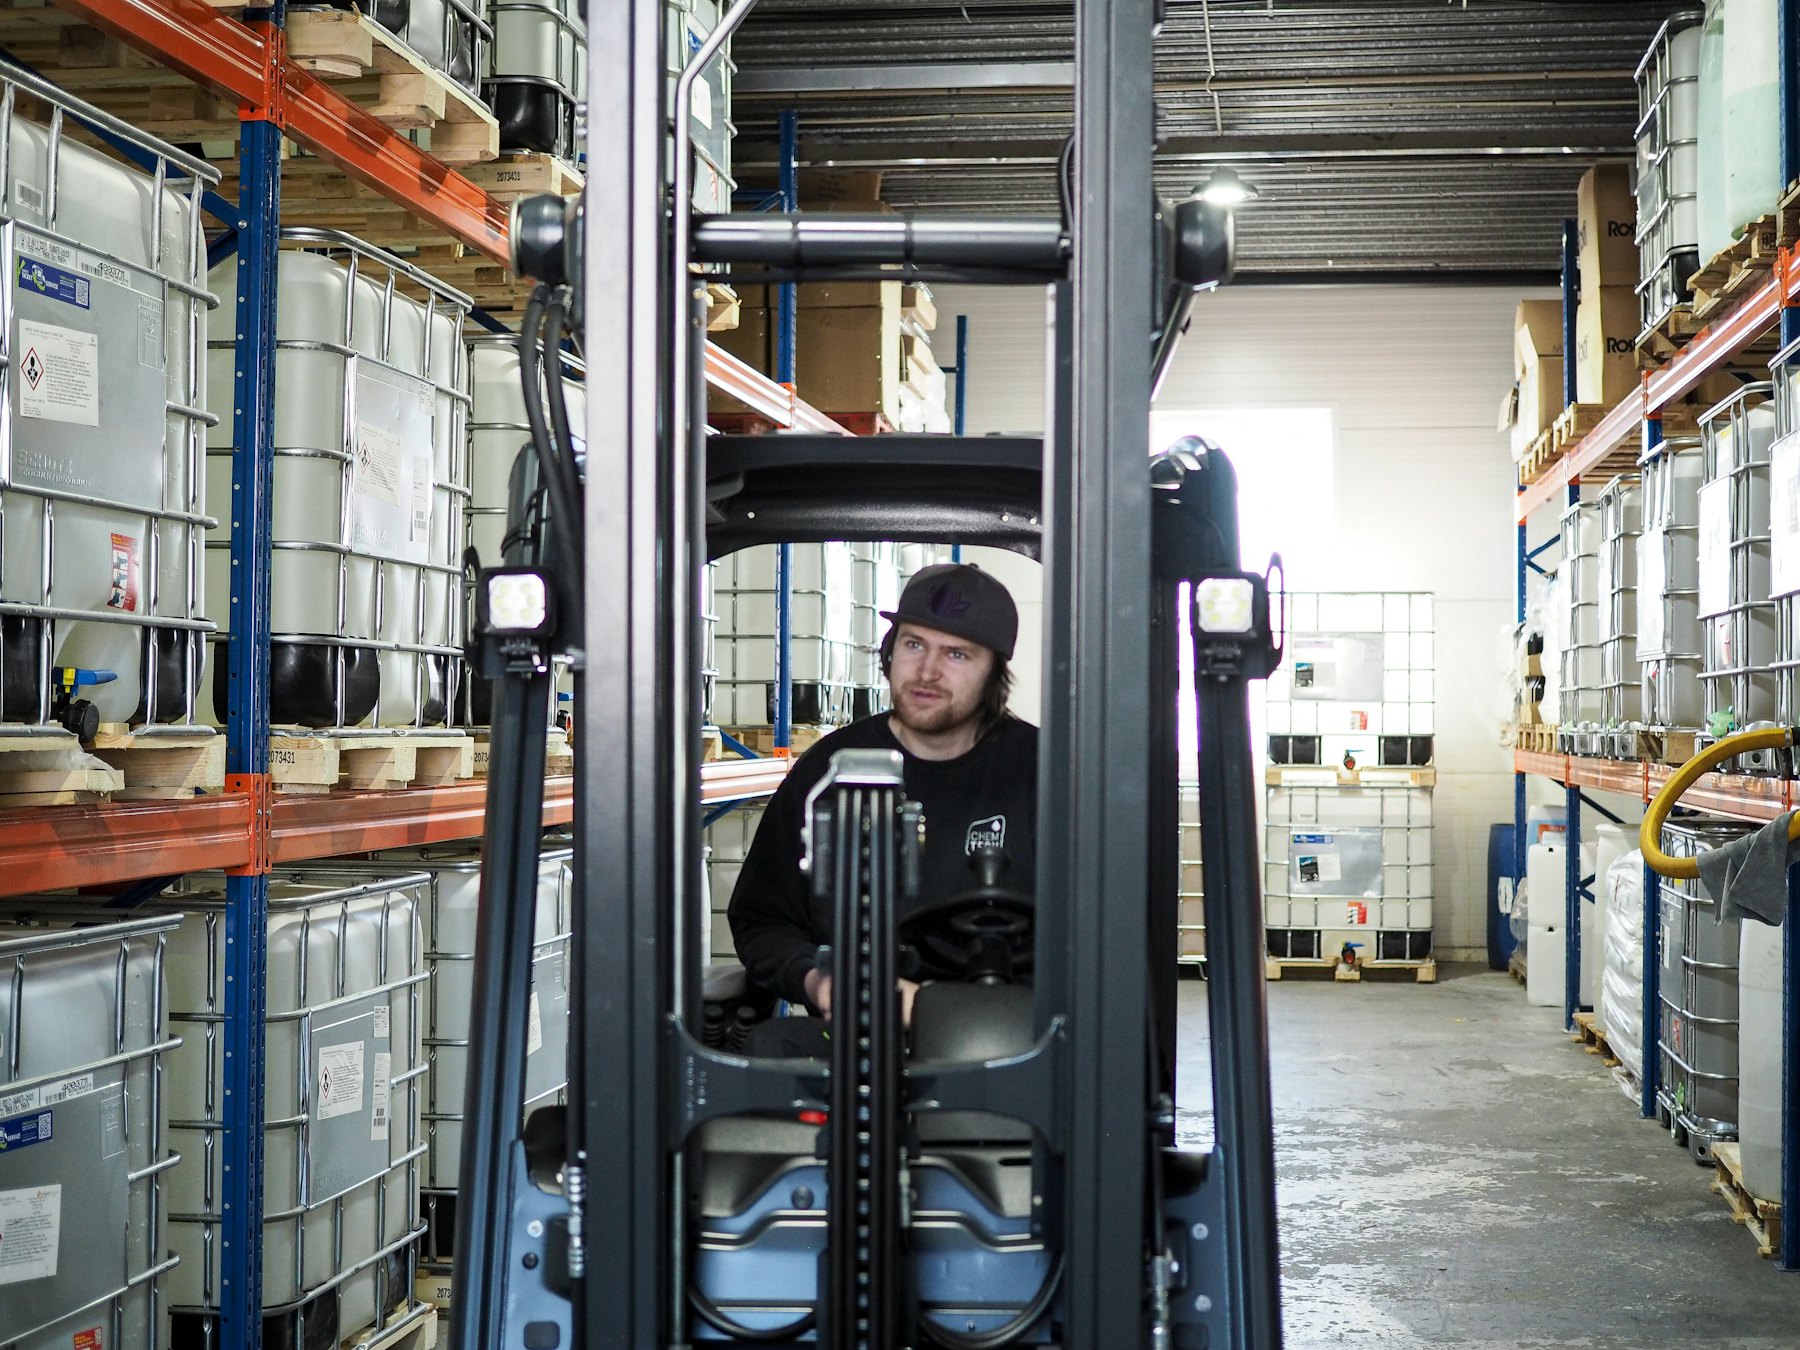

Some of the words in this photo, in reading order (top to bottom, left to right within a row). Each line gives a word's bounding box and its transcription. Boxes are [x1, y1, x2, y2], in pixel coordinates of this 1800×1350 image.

[497, 171, 520, 182] 2073431
[475, 752, 489, 763] 2073
[970, 831, 1000, 841] CHEM
[437, 1287, 452, 1299] 2073
